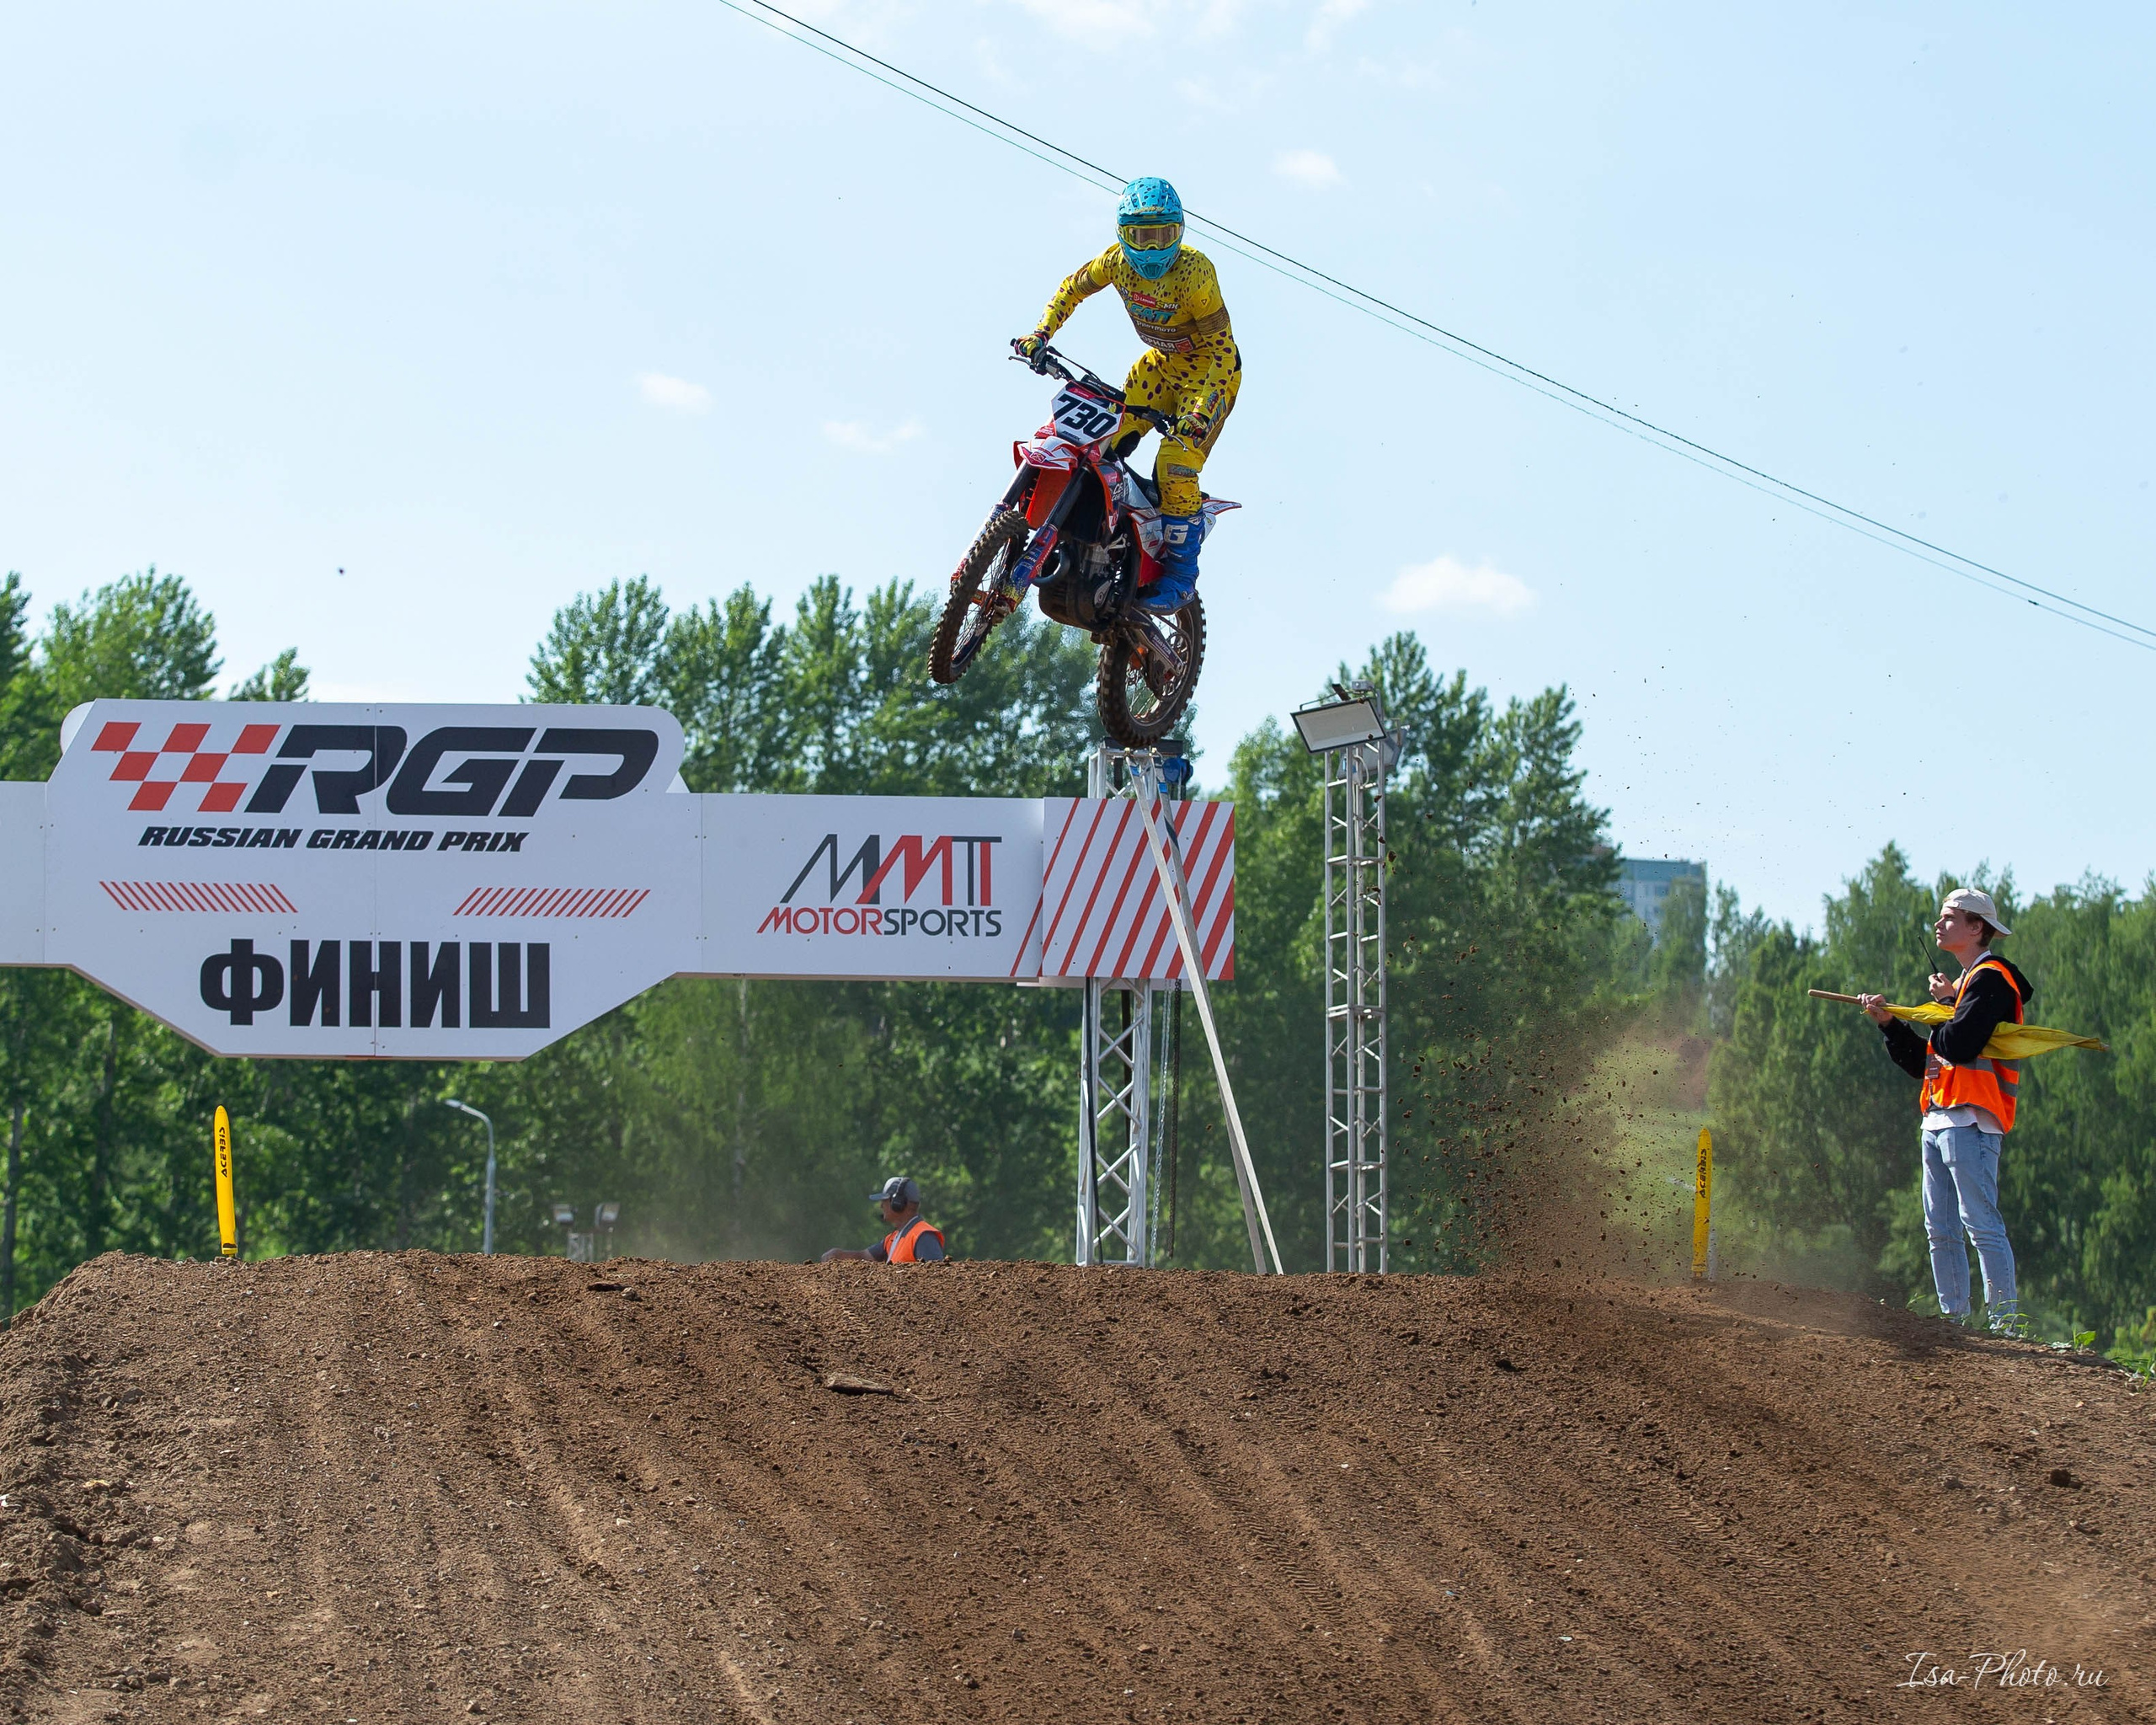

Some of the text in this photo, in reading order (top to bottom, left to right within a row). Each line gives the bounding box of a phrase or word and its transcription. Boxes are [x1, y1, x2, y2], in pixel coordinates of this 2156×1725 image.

[1054, 393, 1118, 440] 730
[244, 724, 659, 818] RGP
[137, 826, 531, 852] RUSSIAN GRAND PRIX
[756, 905, 1002, 937] MOTORSPORTS
[200, 937, 551, 1029] ФИНИШ
